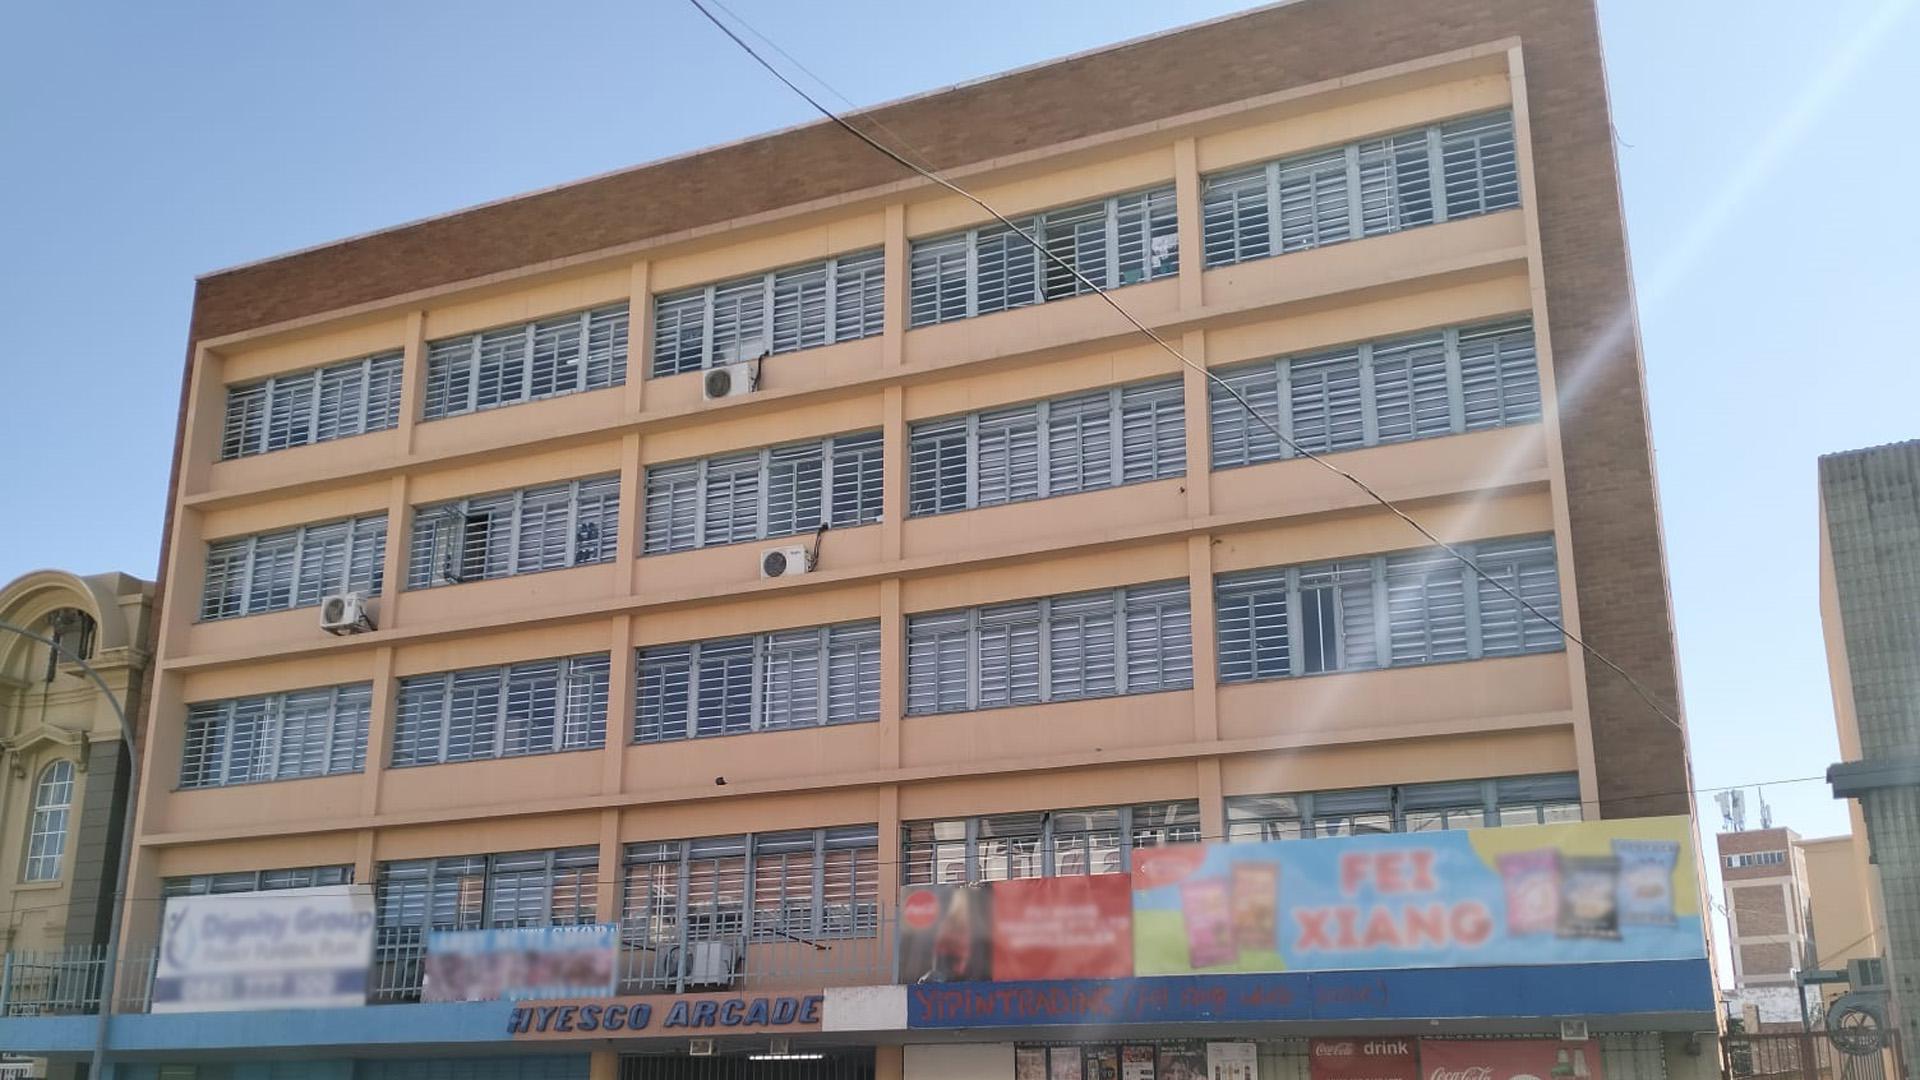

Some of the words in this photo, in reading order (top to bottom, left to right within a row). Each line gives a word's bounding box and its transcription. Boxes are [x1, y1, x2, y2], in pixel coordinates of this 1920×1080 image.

[1340, 851, 1436, 896] FEI
[1294, 902, 1494, 950] XIANG
[663, 995, 826, 1028] ARCADE
[1363, 1041, 1408, 1055] drink
